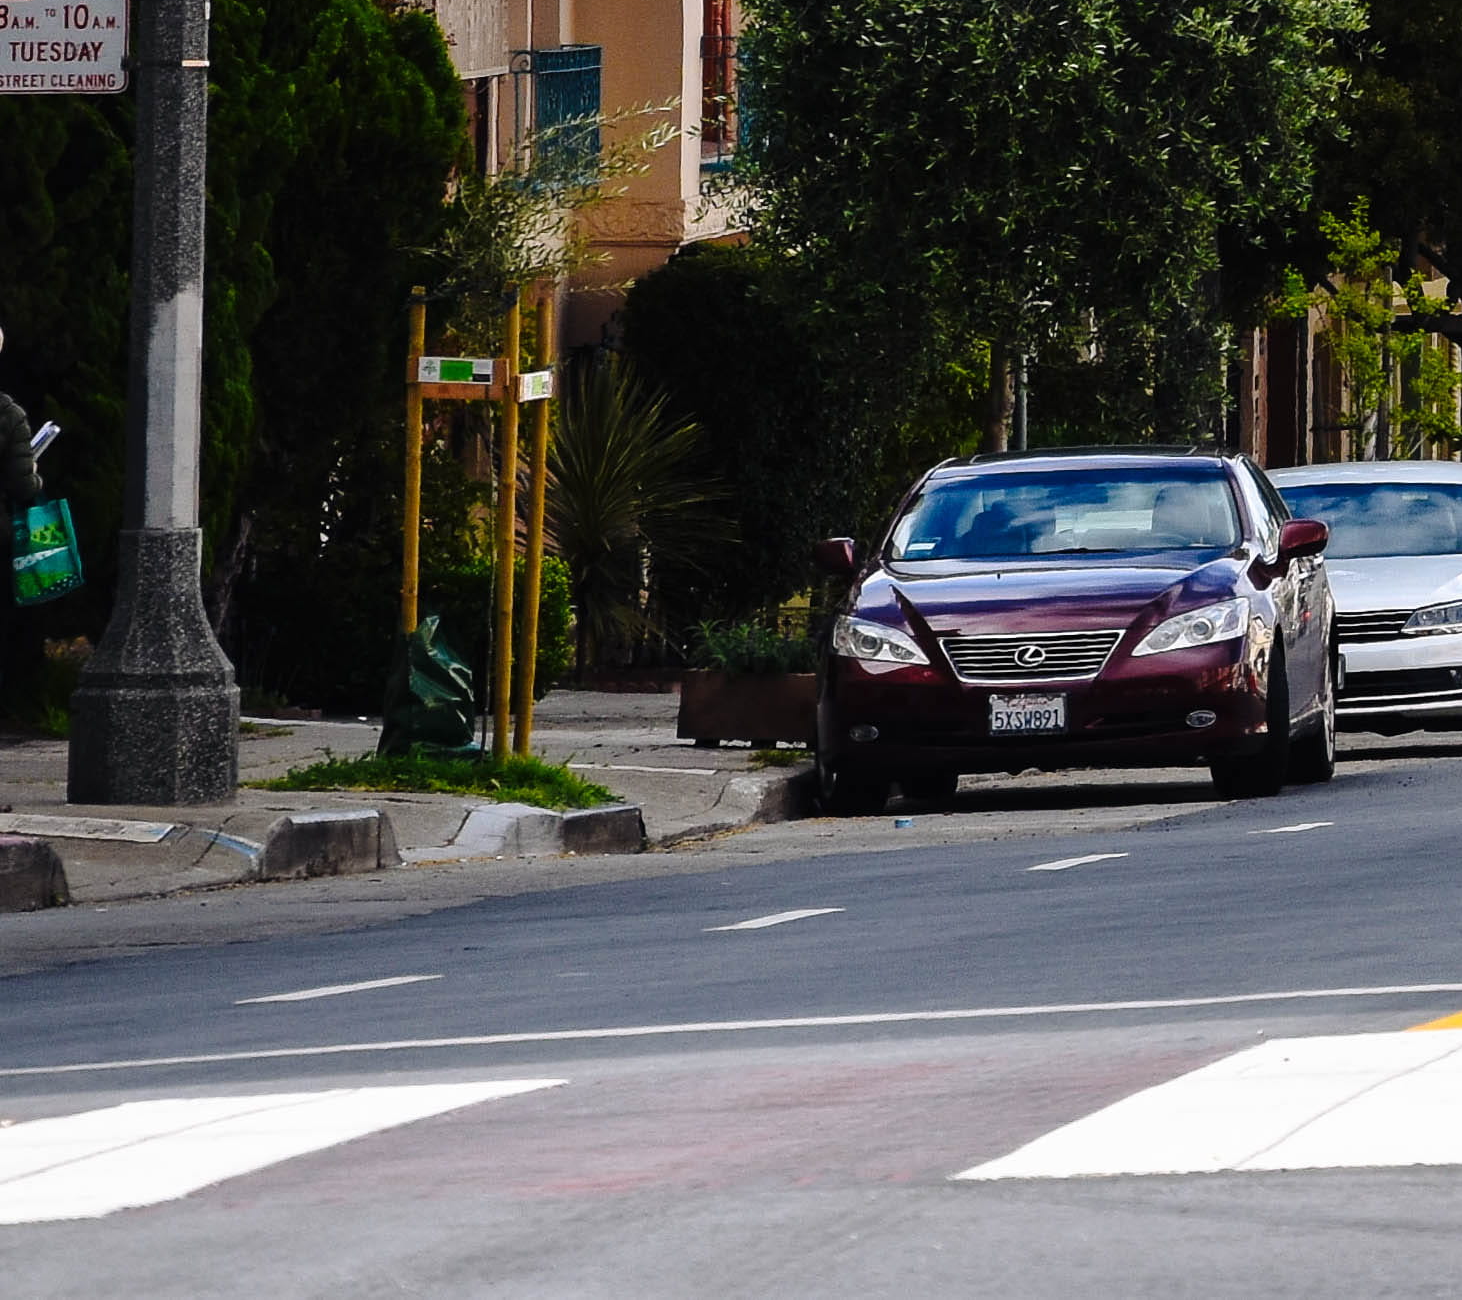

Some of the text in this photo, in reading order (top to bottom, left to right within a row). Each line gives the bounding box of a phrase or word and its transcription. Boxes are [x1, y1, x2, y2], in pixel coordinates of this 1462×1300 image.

[45, 8, 56, 17] TO
[9, 41, 104, 62] TUESDAY
[50, 73, 116, 88] CLEANING
